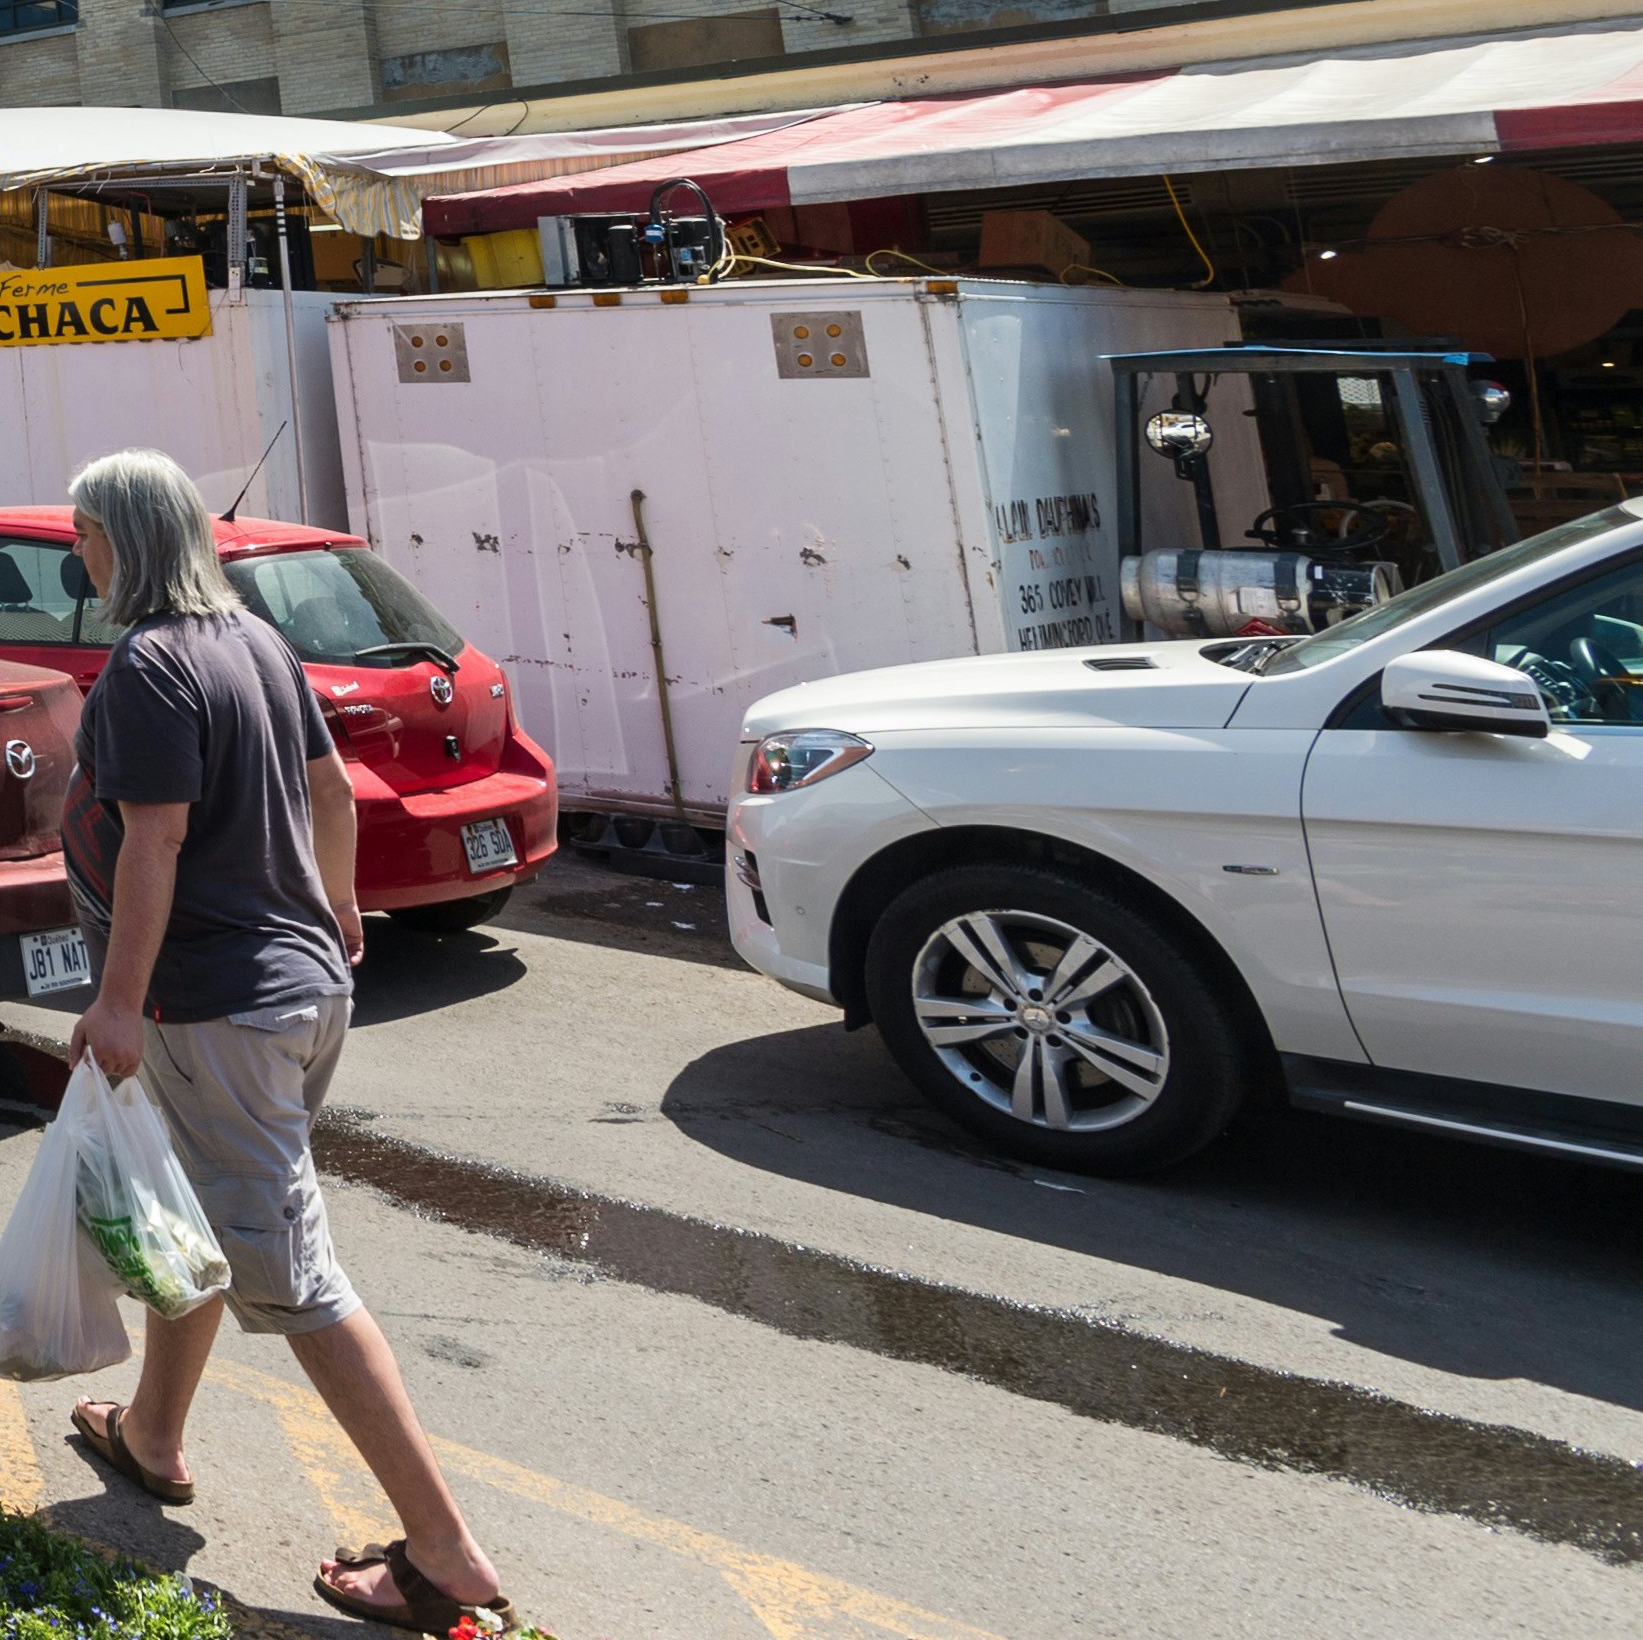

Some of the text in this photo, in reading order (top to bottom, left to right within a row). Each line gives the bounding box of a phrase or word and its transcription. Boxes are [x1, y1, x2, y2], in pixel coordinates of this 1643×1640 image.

[1019, 584, 1044, 615] 365
[466, 834, 488, 860] 326
[29, 940, 88, 980] J81 NAT
